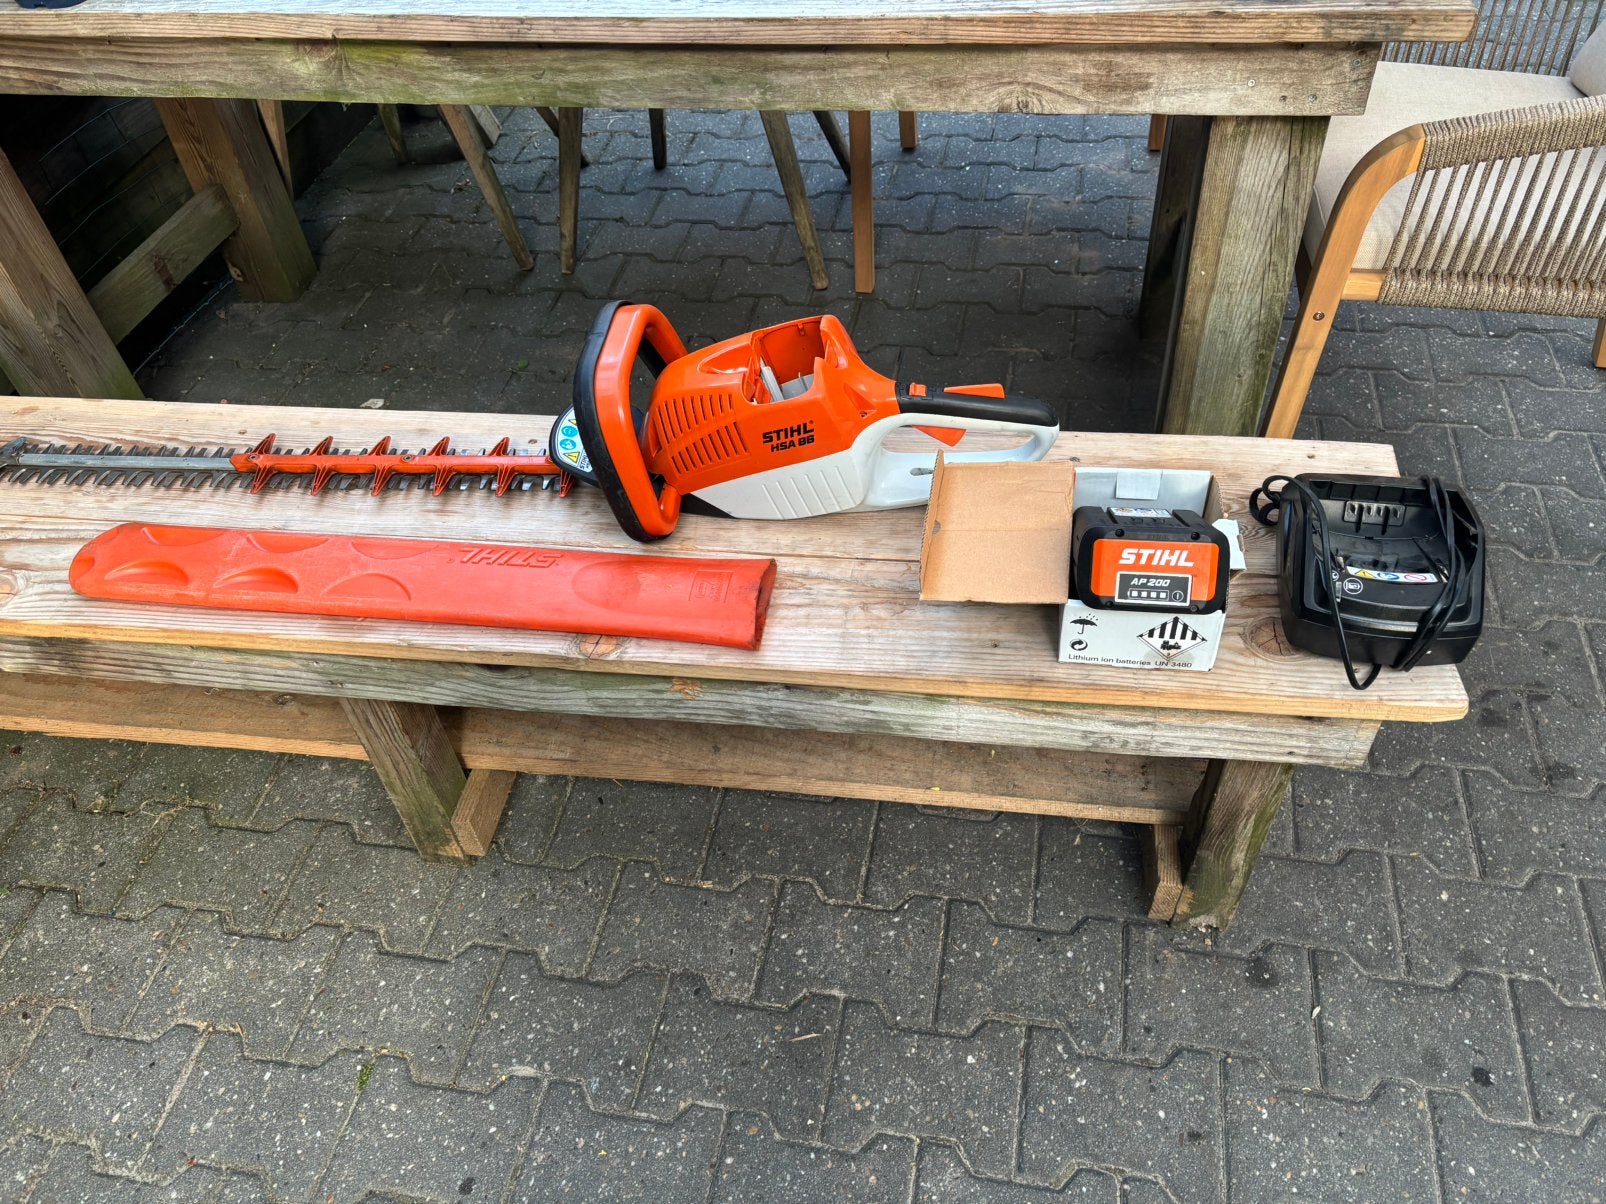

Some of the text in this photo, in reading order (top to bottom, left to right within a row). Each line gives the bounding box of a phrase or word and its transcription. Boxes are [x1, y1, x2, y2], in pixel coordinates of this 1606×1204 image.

[762, 422, 815, 444] STIHL
[771, 440, 796, 452] HSA
[459, 547, 564, 568] STIHL
[1118, 548, 1195, 567] STIHL
[1130, 577, 1171, 587] AP 200
[1068, 653, 1099, 662] Lithium
[1101, 656, 1114, 664] ion
[1115, 658, 1151, 666] batteries
[1154, 660, 1169, 668] UN
